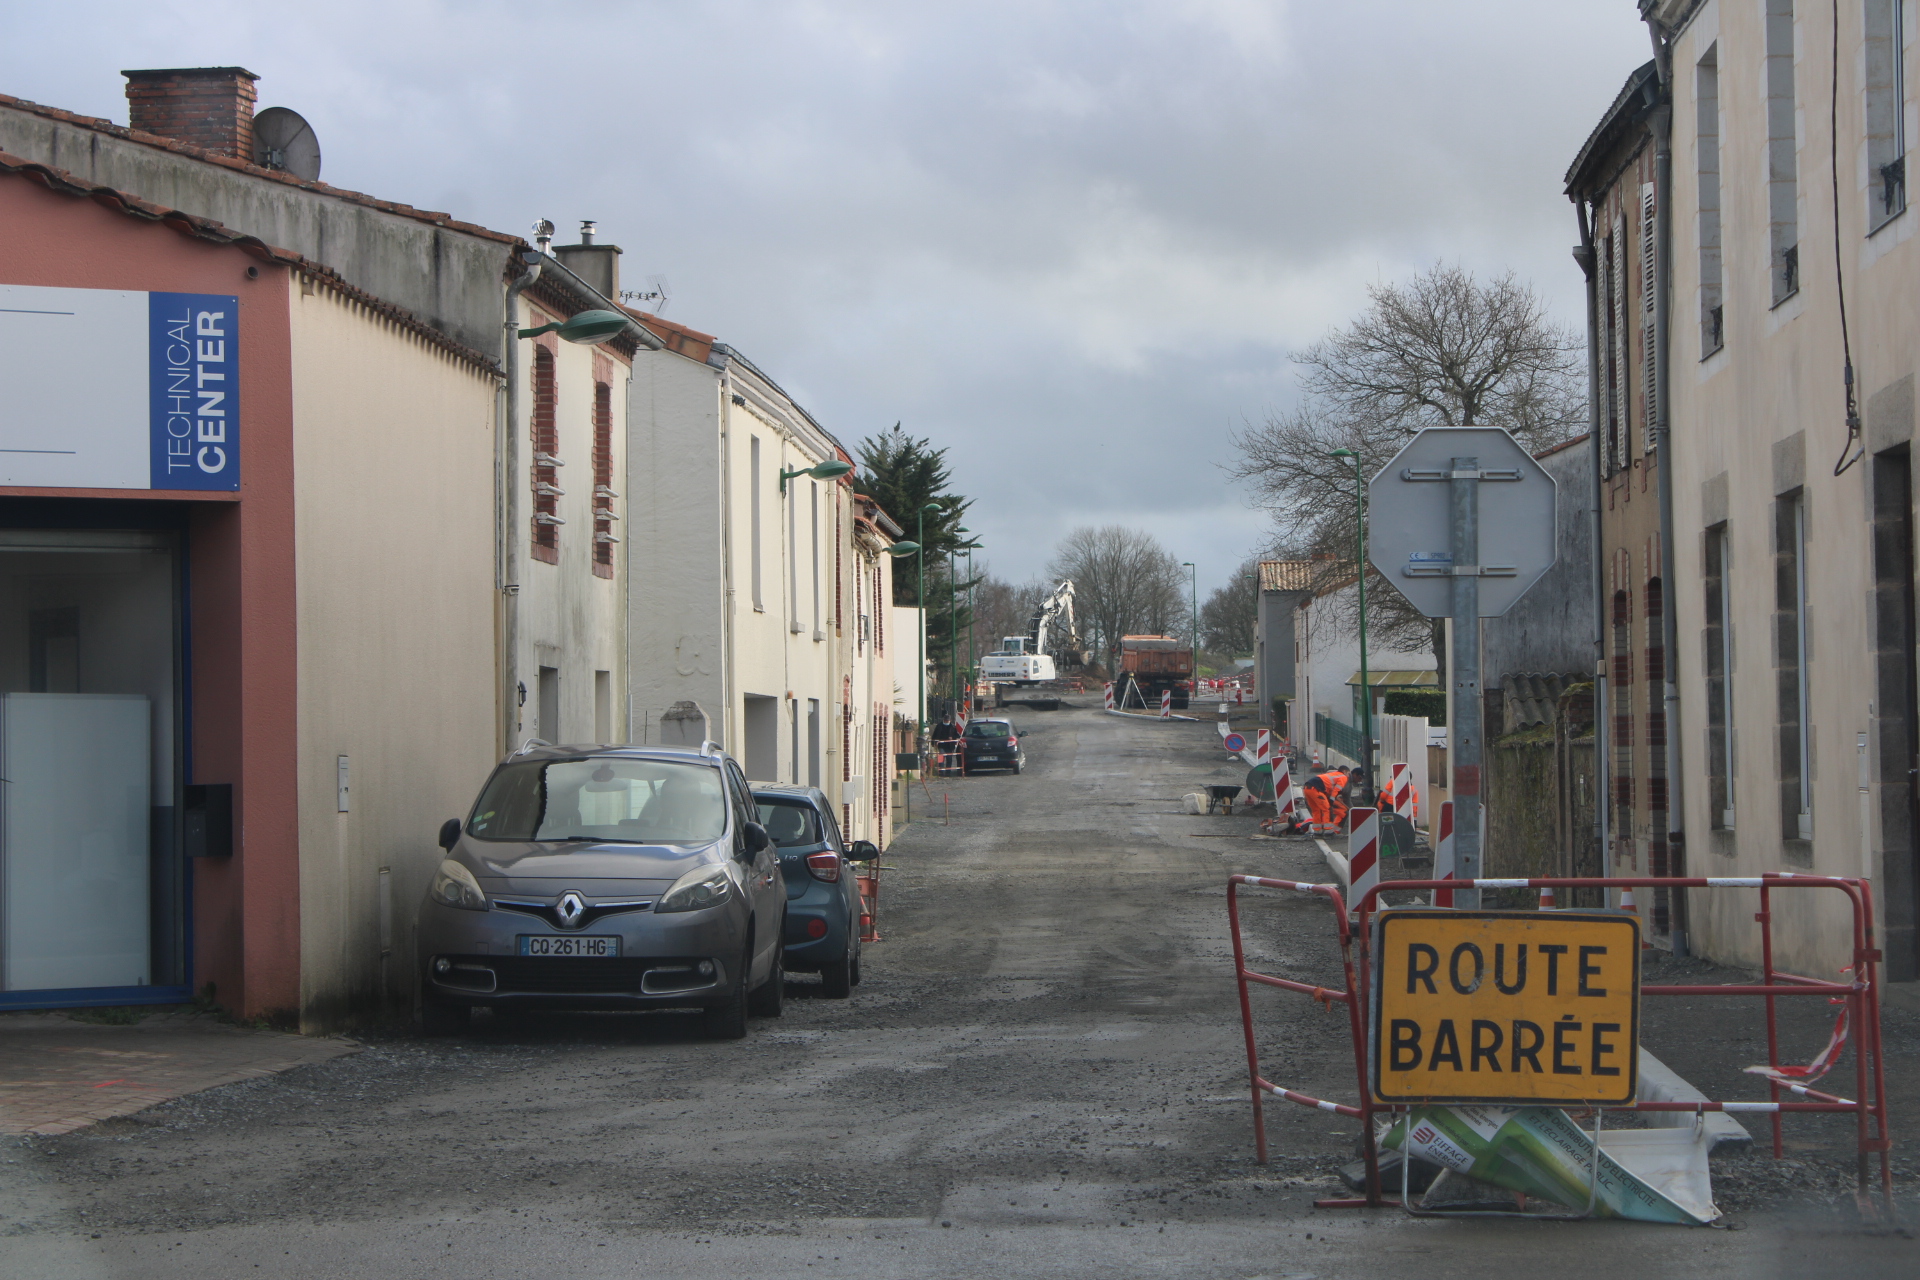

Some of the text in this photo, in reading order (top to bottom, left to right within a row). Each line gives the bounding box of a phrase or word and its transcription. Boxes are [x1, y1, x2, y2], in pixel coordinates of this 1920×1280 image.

[167, 307, 191, 475] TECHNICAL
[196, 311, 226, 474] CENTER
[1407, 941, 1607, 997] ROUTE
[1390, 1014, 1620, 1076] BARRÉE
[1428, 1144, 1462, 1170] ÉNERGIE
[1433, 1136, 1469, 1165] EIFFAGE
[1528, 1115, 1539, 1127] ET
[1538, 1121, 1587, 1164] L'ÉCLAIRAGE
